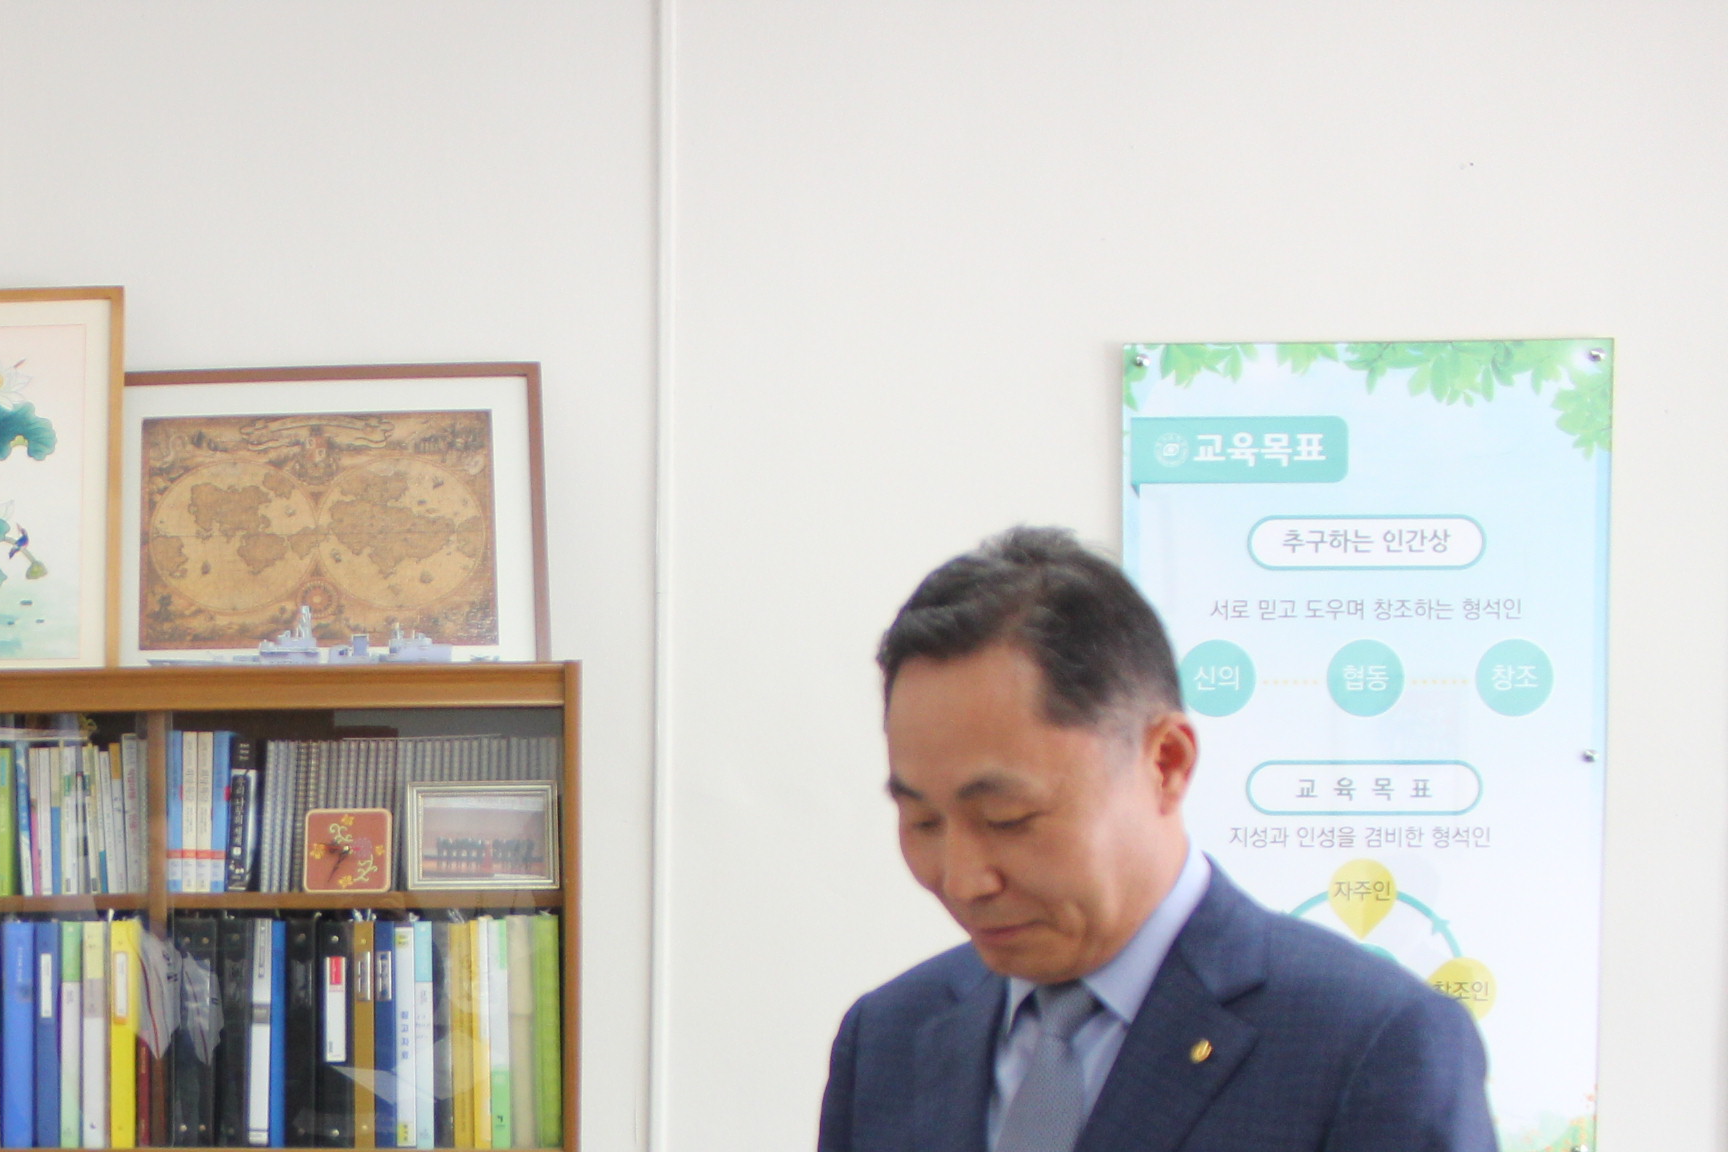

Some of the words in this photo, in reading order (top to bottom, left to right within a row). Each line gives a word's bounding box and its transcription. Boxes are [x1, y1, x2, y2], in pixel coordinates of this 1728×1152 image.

[1193, 432, 1326, 465] 교육목표
[1282, 529, 1374, 554] 추구하는
[1383, 529, 1451, 554] 인간상
[1210, 599, 1250, 621] 서로
[1258, 599, 1298, 621] 믿고
[1305, 599, 1365, 621] 도우며
[1373, 598, 1454, 621] 창조하는
[1462, 598, 1522, 621] 형석인
[1194, 665, 1240, 691] 신의
[1343, 664, 1390, 692] 협동
[1491, 664, 1539, 691] 창조
[1229, 826, 1290, 848] 지성과
[1297, 826, 1357, 848] 인성을
[1365, 826, 1424, 848] 겸비한
[1432, 826, 1491, 848] 형석인
[1334, 880, 1392, 902] 자주인
